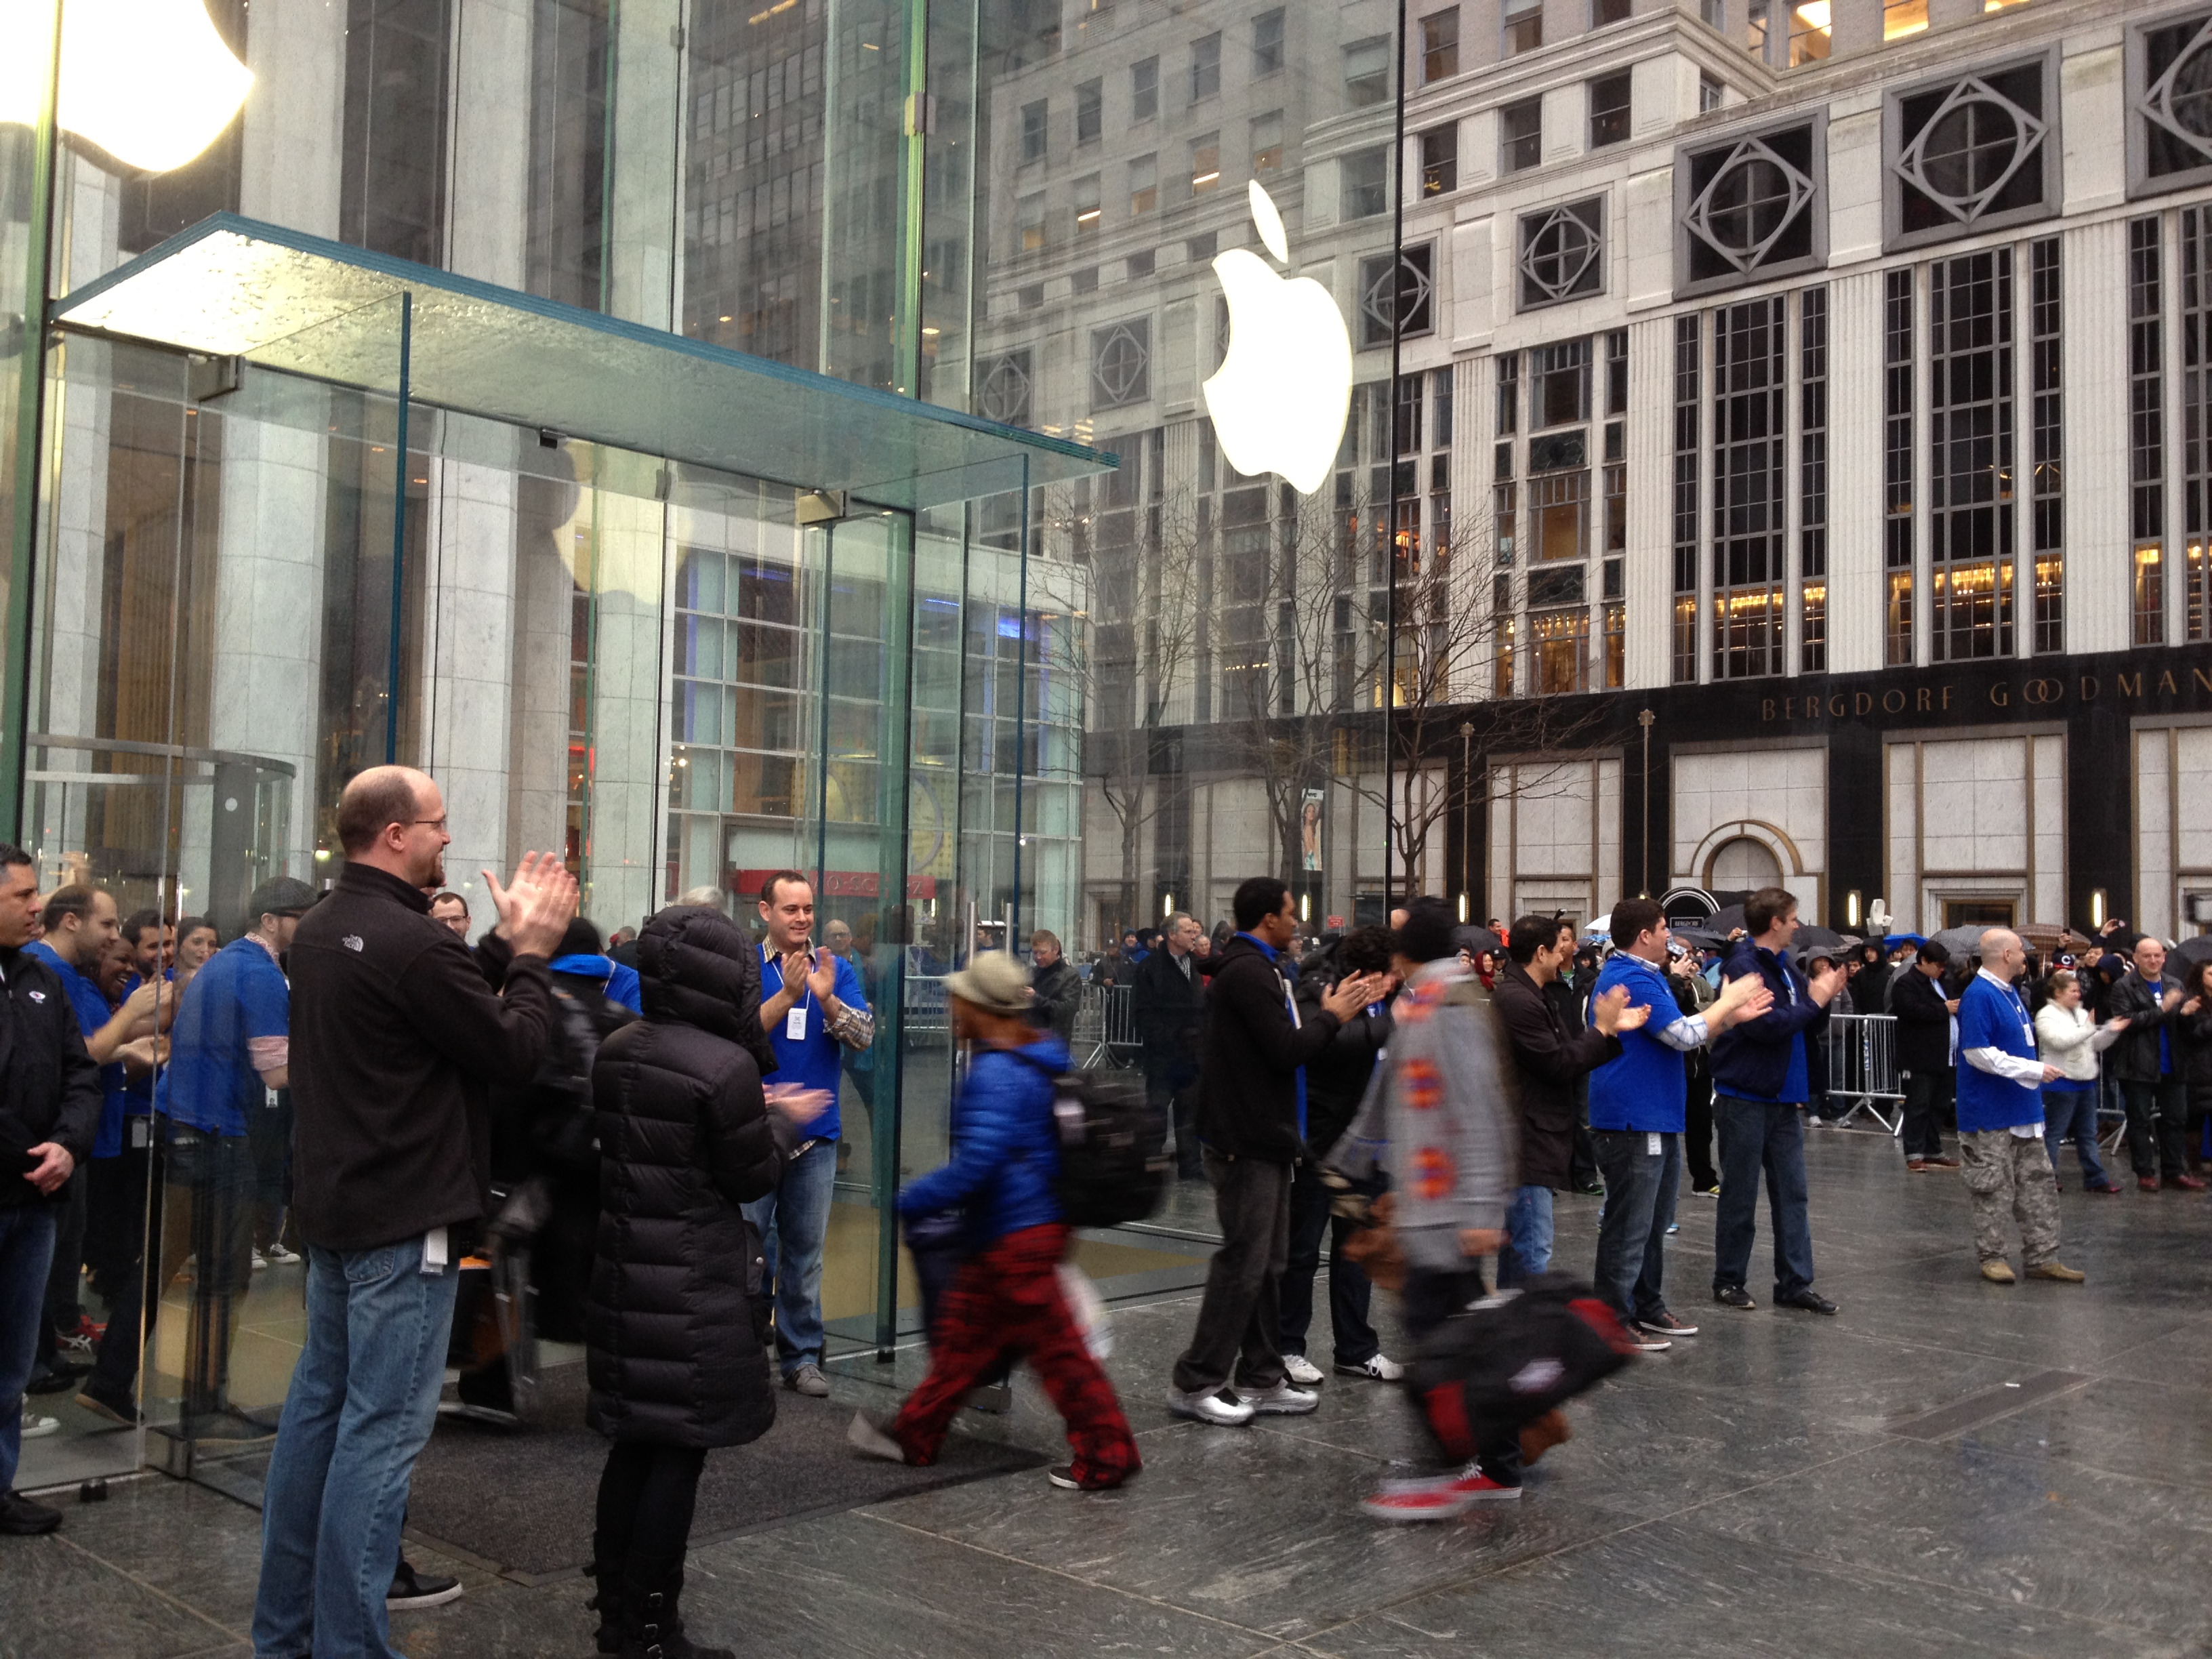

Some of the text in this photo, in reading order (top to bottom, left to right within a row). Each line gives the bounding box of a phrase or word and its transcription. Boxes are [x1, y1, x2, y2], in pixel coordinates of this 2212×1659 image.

[1762, 668, 2212, 722] BERGDORF GOODMAN
[2061, 955, 2070, 965] C
